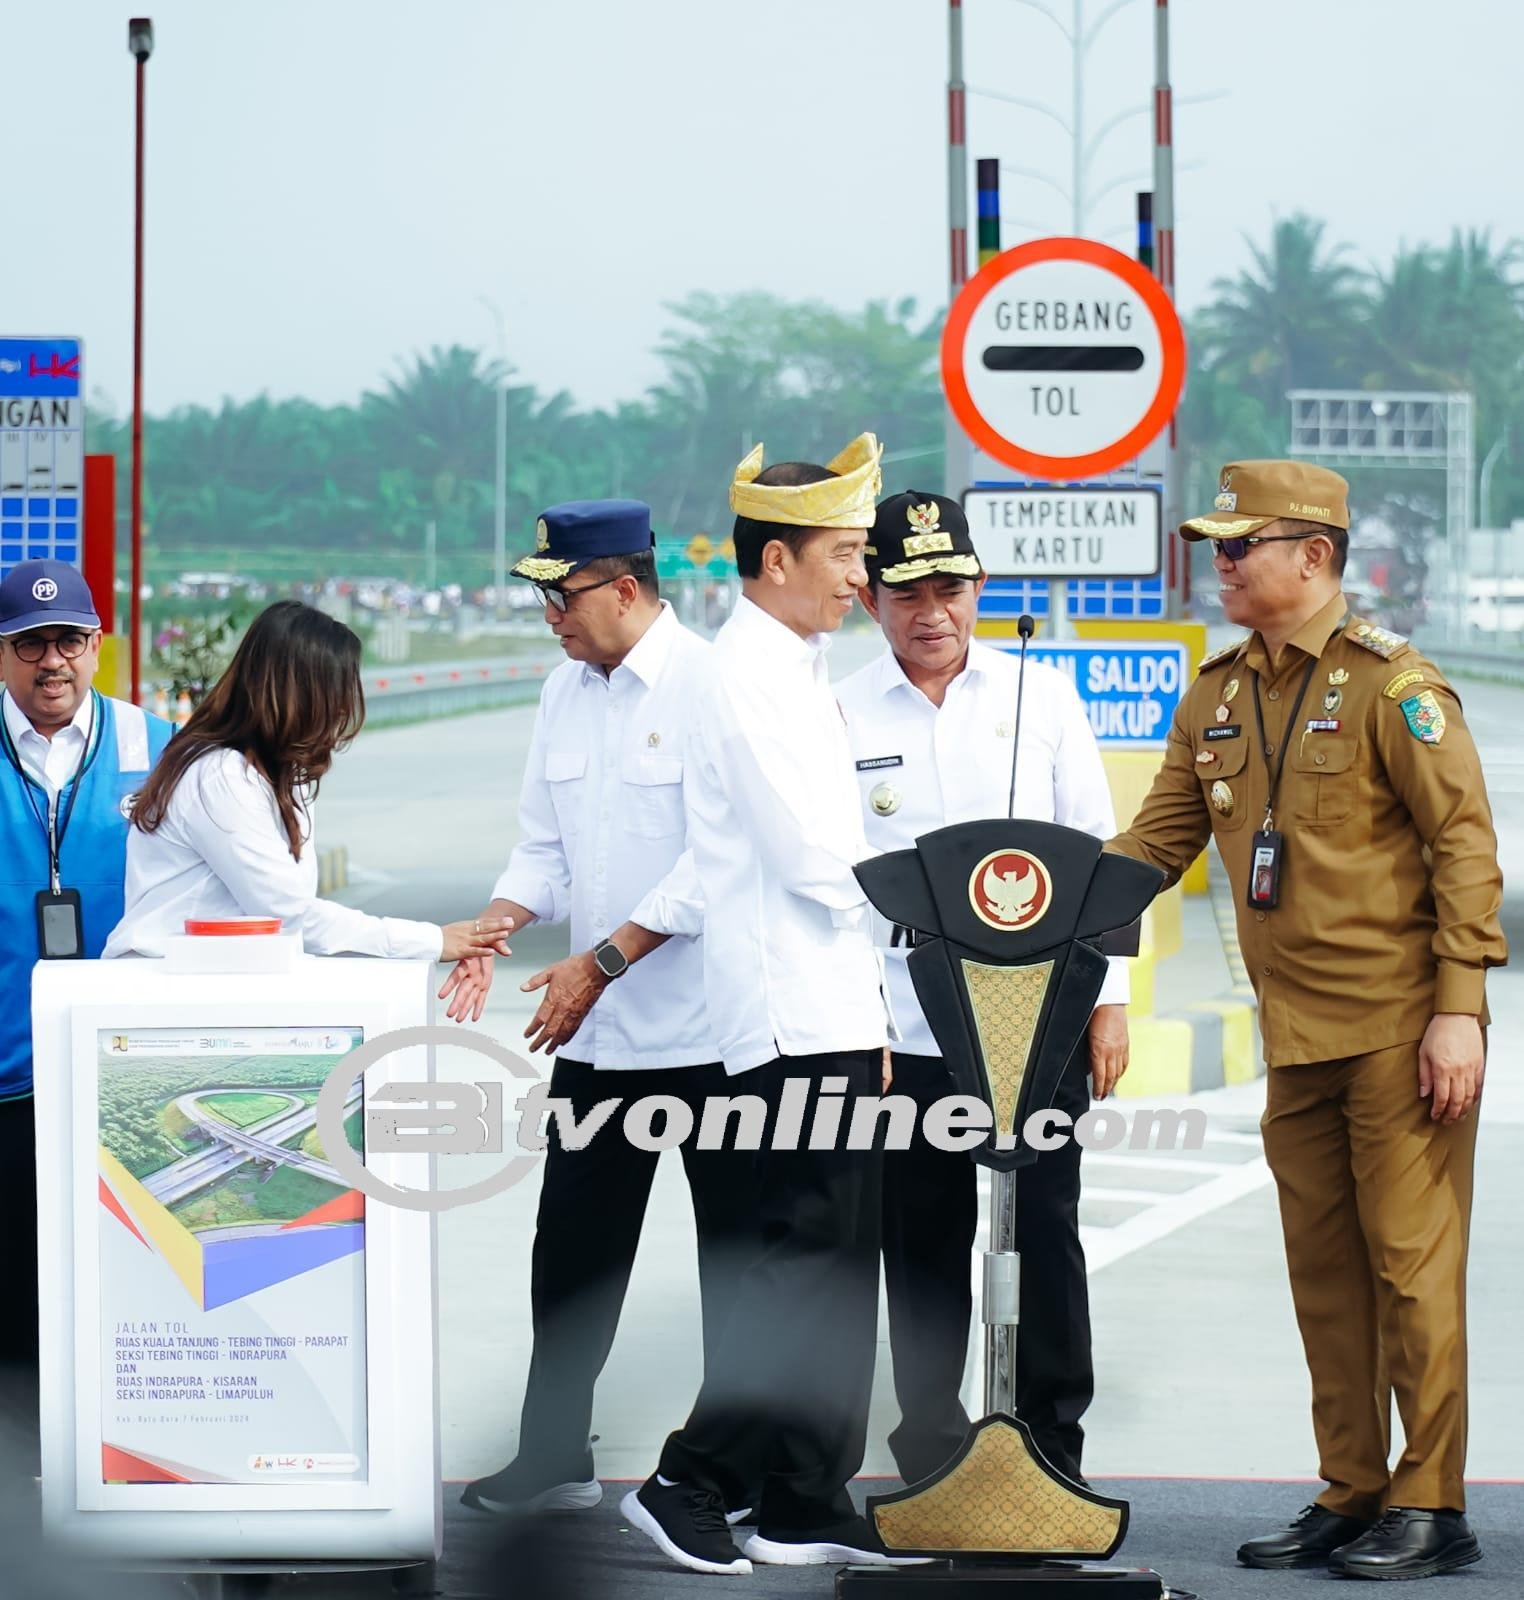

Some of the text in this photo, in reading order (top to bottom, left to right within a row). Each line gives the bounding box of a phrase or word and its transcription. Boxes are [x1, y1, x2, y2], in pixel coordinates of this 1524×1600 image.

[995, 302, 1133, 331] GERBANG
[1030, 386, 1080, 416] TOL
[988, 501, 1137, 529] TEMPELKAN
[1013, 537, 1104, 565] KARTU
[37, 583, 54, 597] PP
[1087, 655, 1179, 693] SALDO
[115, 1323, 190, 1333] JALAN TOL
[115, 1338, 141, 1347] RUAS
[143, 1338, 175, 1347] KUALA
[177, 1337, 219, 1347] TANJUNG
[228, 1337, 262, 1347] TEBING
[265, 1337, 296, 1347] TINGGI
[305, 1336, 348, 1346] PARAPAT
[115, 1351, 144, 1360] SEKSI
[147, 1351, 183, 1360] TEBING
[187, 1351, 219, 1360] TINGGI
[229, 1350, 287, 1360] INDRAPURA
[116, 1364, 136, 1374] DAN
[116, 1377, 142, 1386] RUAS
[145, 1377, 203, 1386] INDRAPURA
[213, 1376, 257, 1386] KISARAN
[116, 1390, 145, 1399] SEKSI
[148, 1390, 206, 1399] INDRAPURA
[216, 1389, 274, 1399] LIMAPULUH
